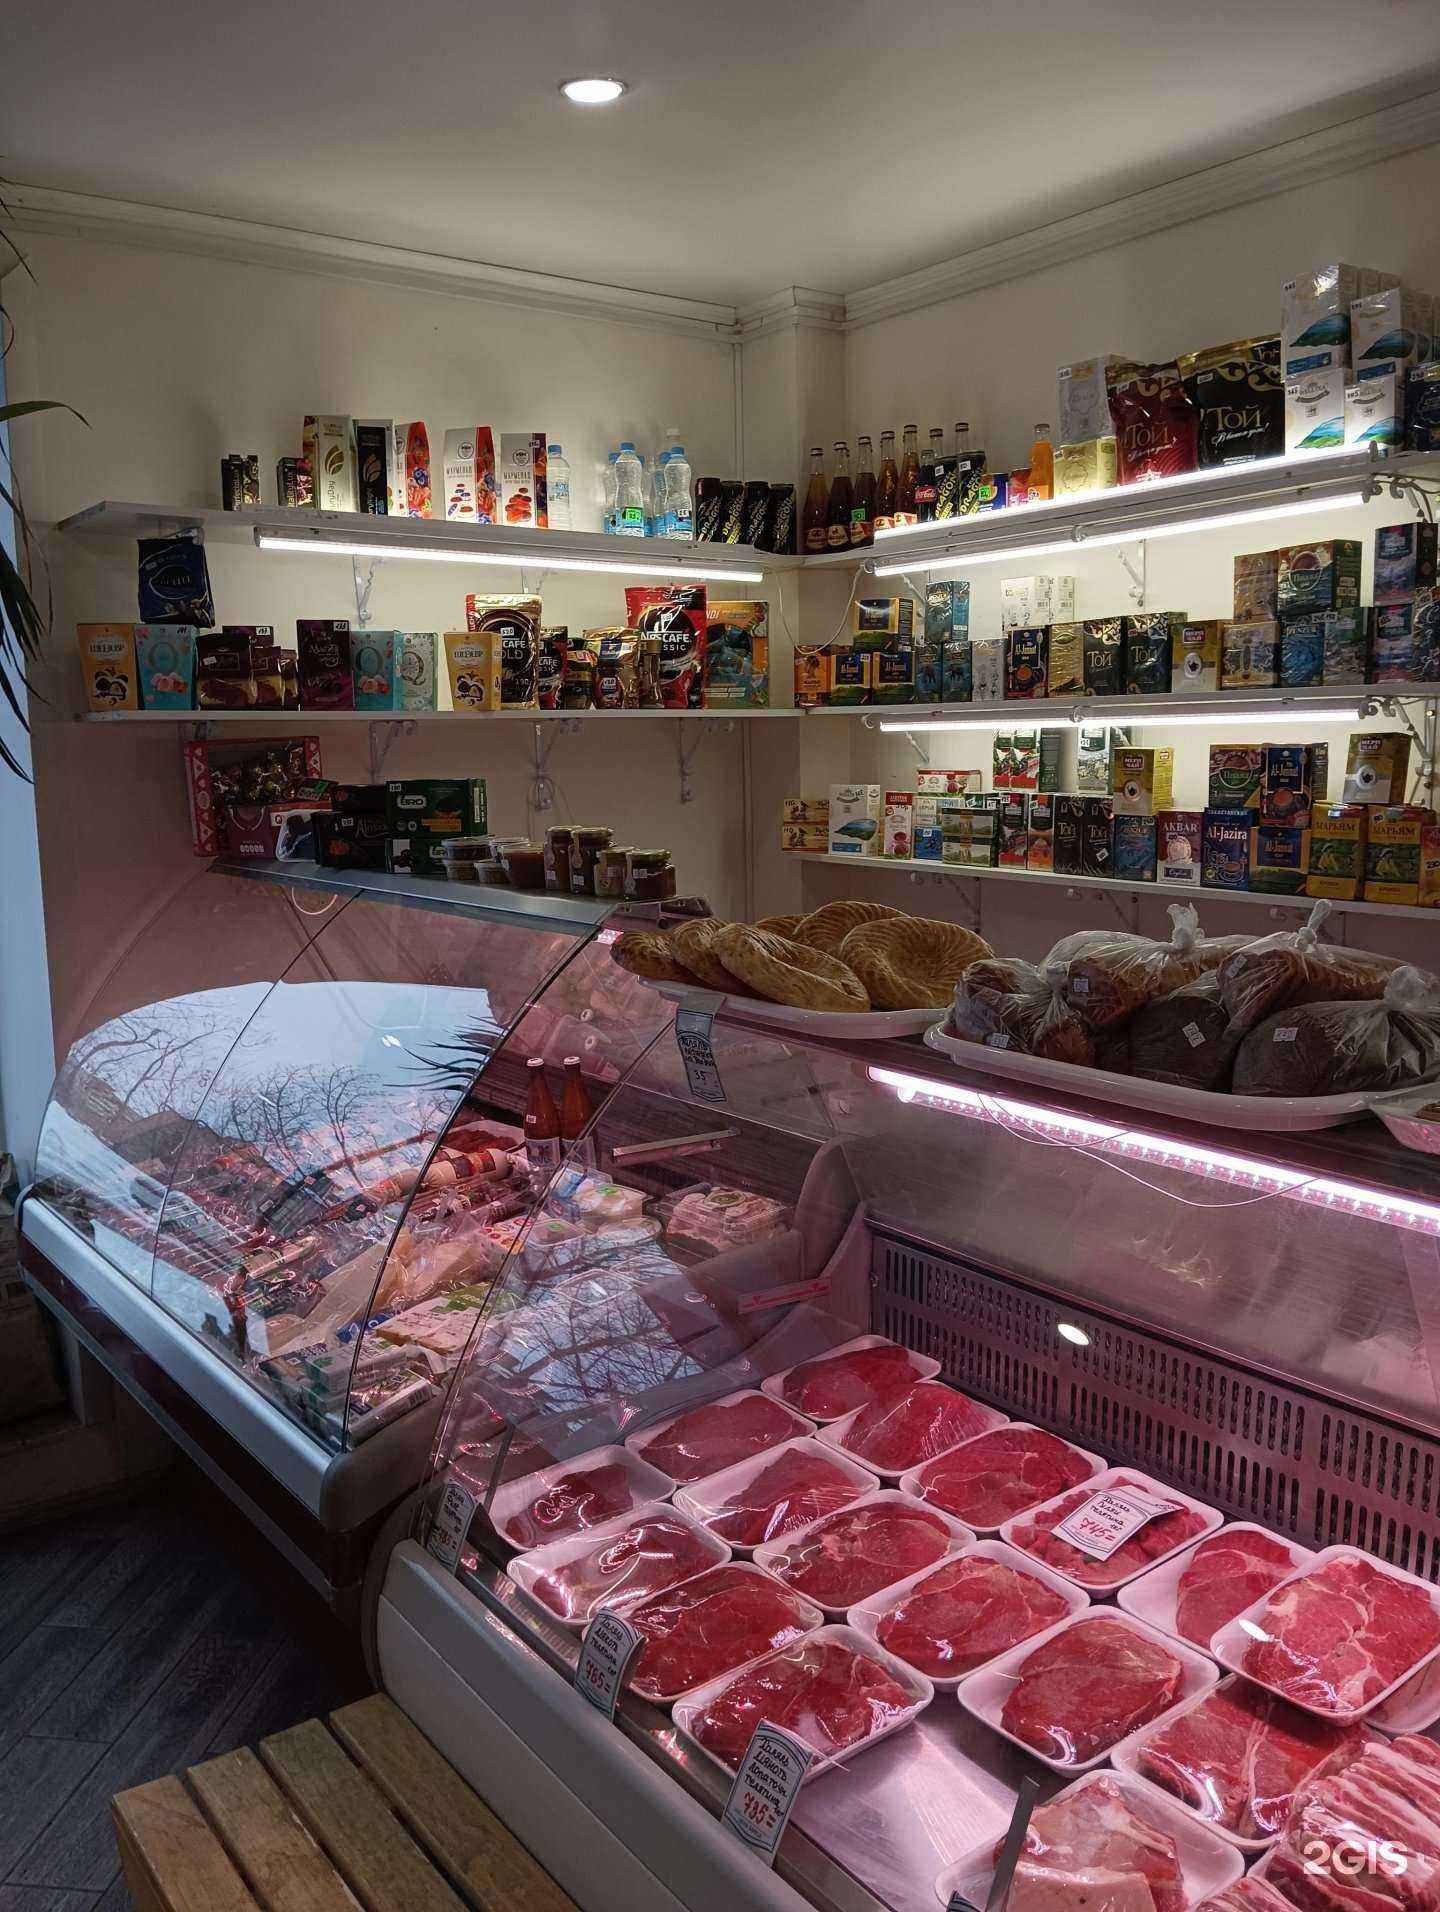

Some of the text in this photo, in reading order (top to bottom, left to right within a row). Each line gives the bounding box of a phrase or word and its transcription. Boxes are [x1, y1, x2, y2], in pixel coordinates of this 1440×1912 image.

[1205, 404, 1264, 431] Той
[1162, 822, 1199, 833] AKBAR
[1206, 826, 1248, 842] Al-Jazira
